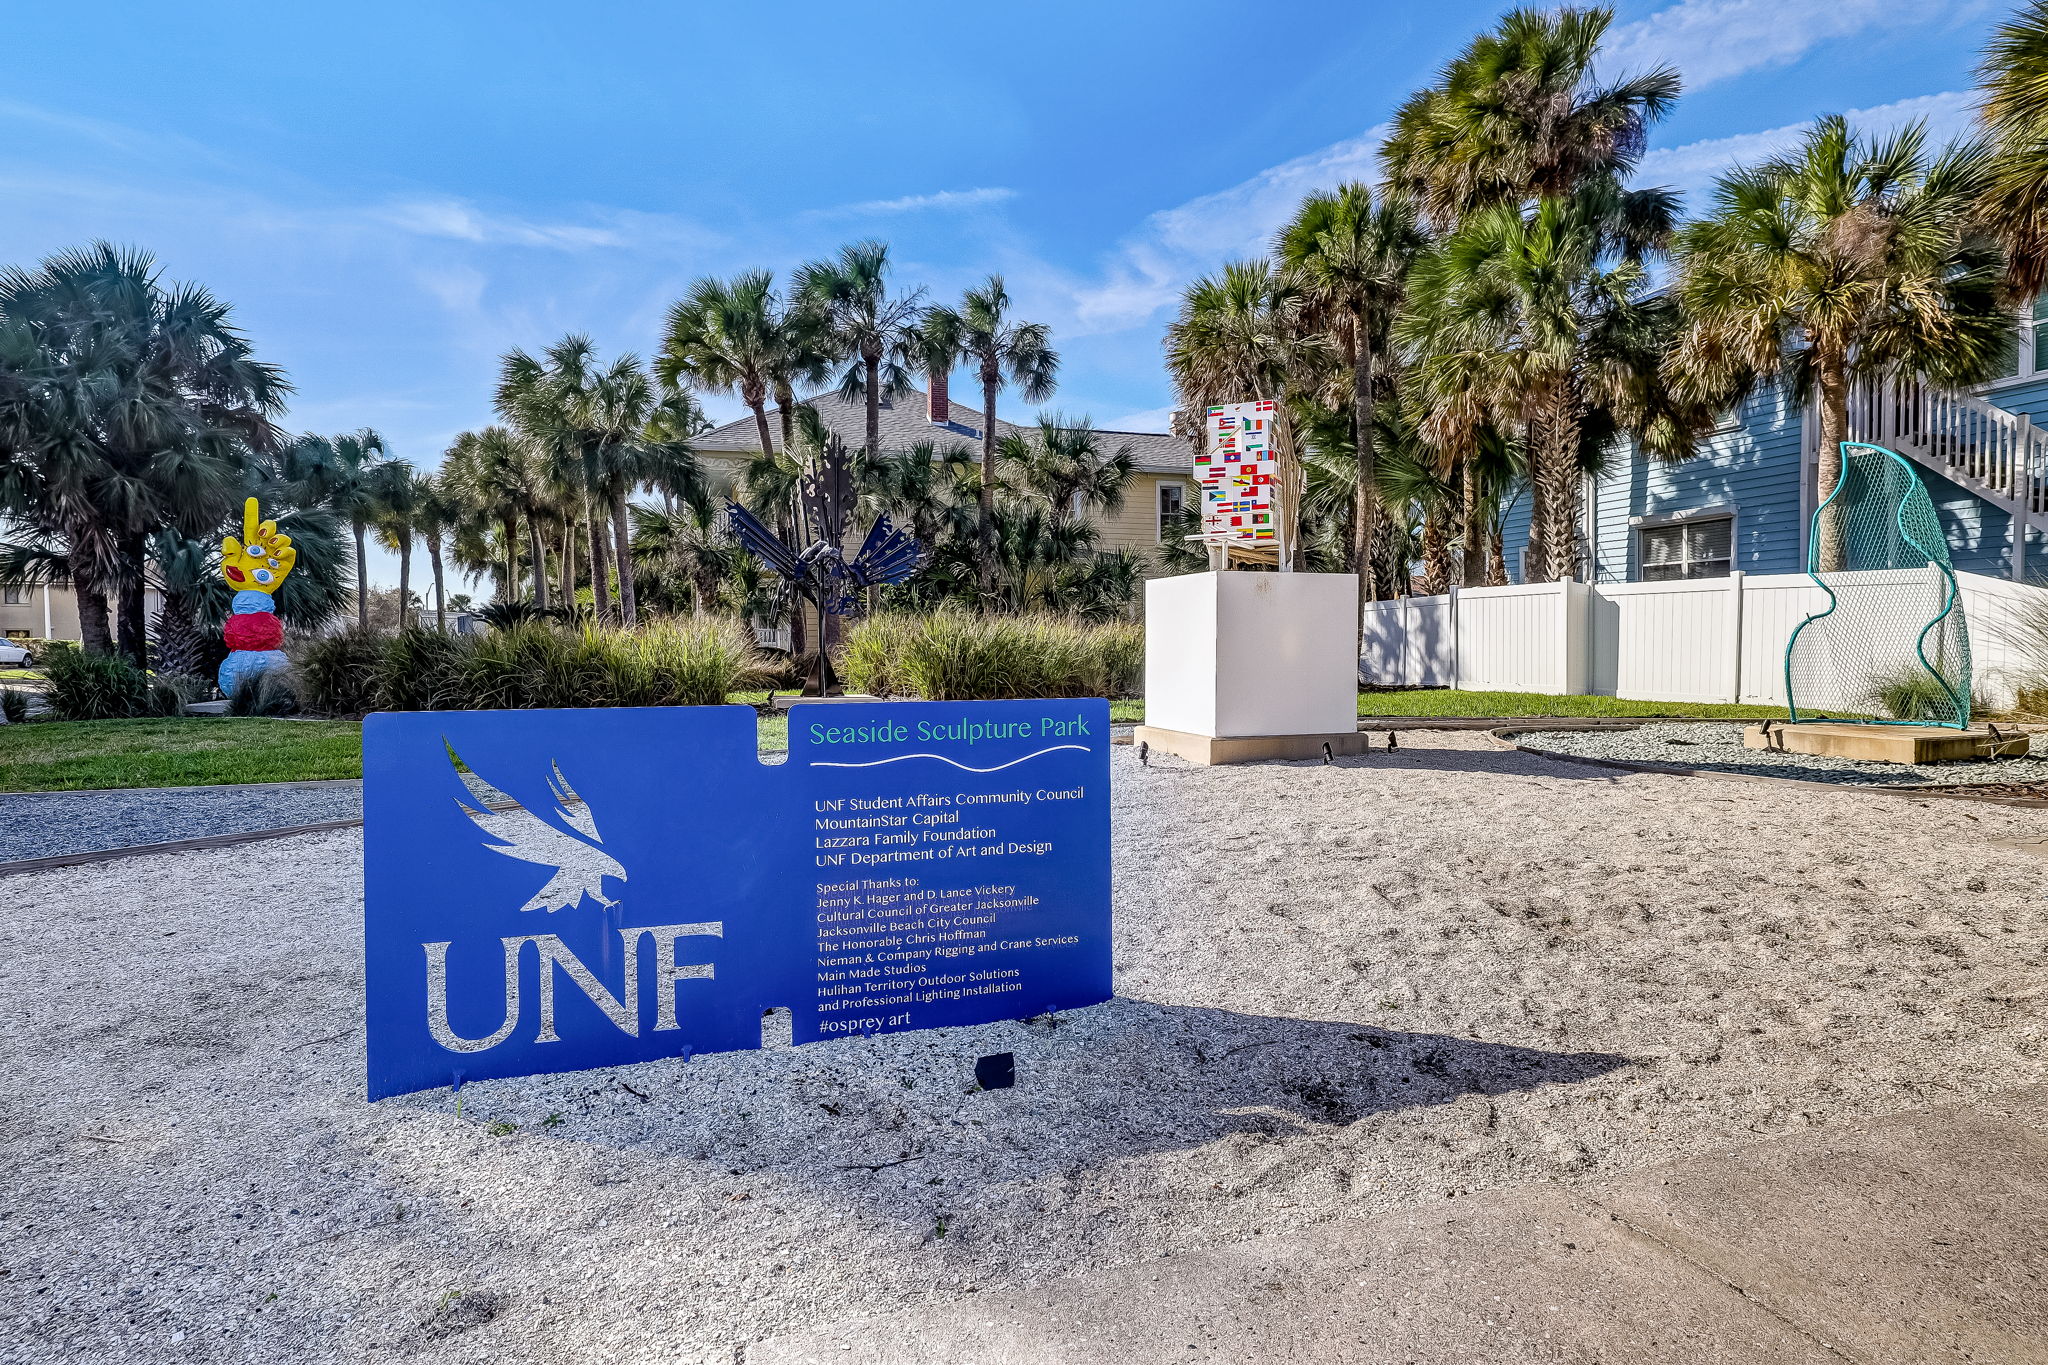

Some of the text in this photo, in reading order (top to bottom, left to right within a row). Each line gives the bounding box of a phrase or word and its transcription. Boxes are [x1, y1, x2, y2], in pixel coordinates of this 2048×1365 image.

[810, 714, 1090, 745] Seaside Sculpture Park
[815, 787, 1084, 812] UNF Student Affairs Community Council
[815, 810, 959, 830] MountainStar Capital
[816, 827, 996, 849] Lazzara Family Foundation
[816, 840, 1052, 867] UNF Department of Art and Design
[817, 877, 919, 894] Special Thanks to:
[817, 884, 1015, 908] Jenny K. Hager and D. Lance Vickery
[817, 895, 1039, 923] Cultural Council of Greater Jacksonville
[817, 913, 996, 938] Jacksonville Beach City Council
[817, 929, 986, 953] The Honorable Chris Hoffman
[818, 934, 1078, 967] Nieman & Company Rigging and Crane Services
[818, 963, 926, 983] Main Made Studios
[818, 968, 1019, 998] Hulihan Territory Outdoor Solutions
[421, 921, 723, 1053] UNF
[818, 982, 1022, 1012] and Professional Lighting Installation
[820, 1011, 911, 1032] #osprey art
